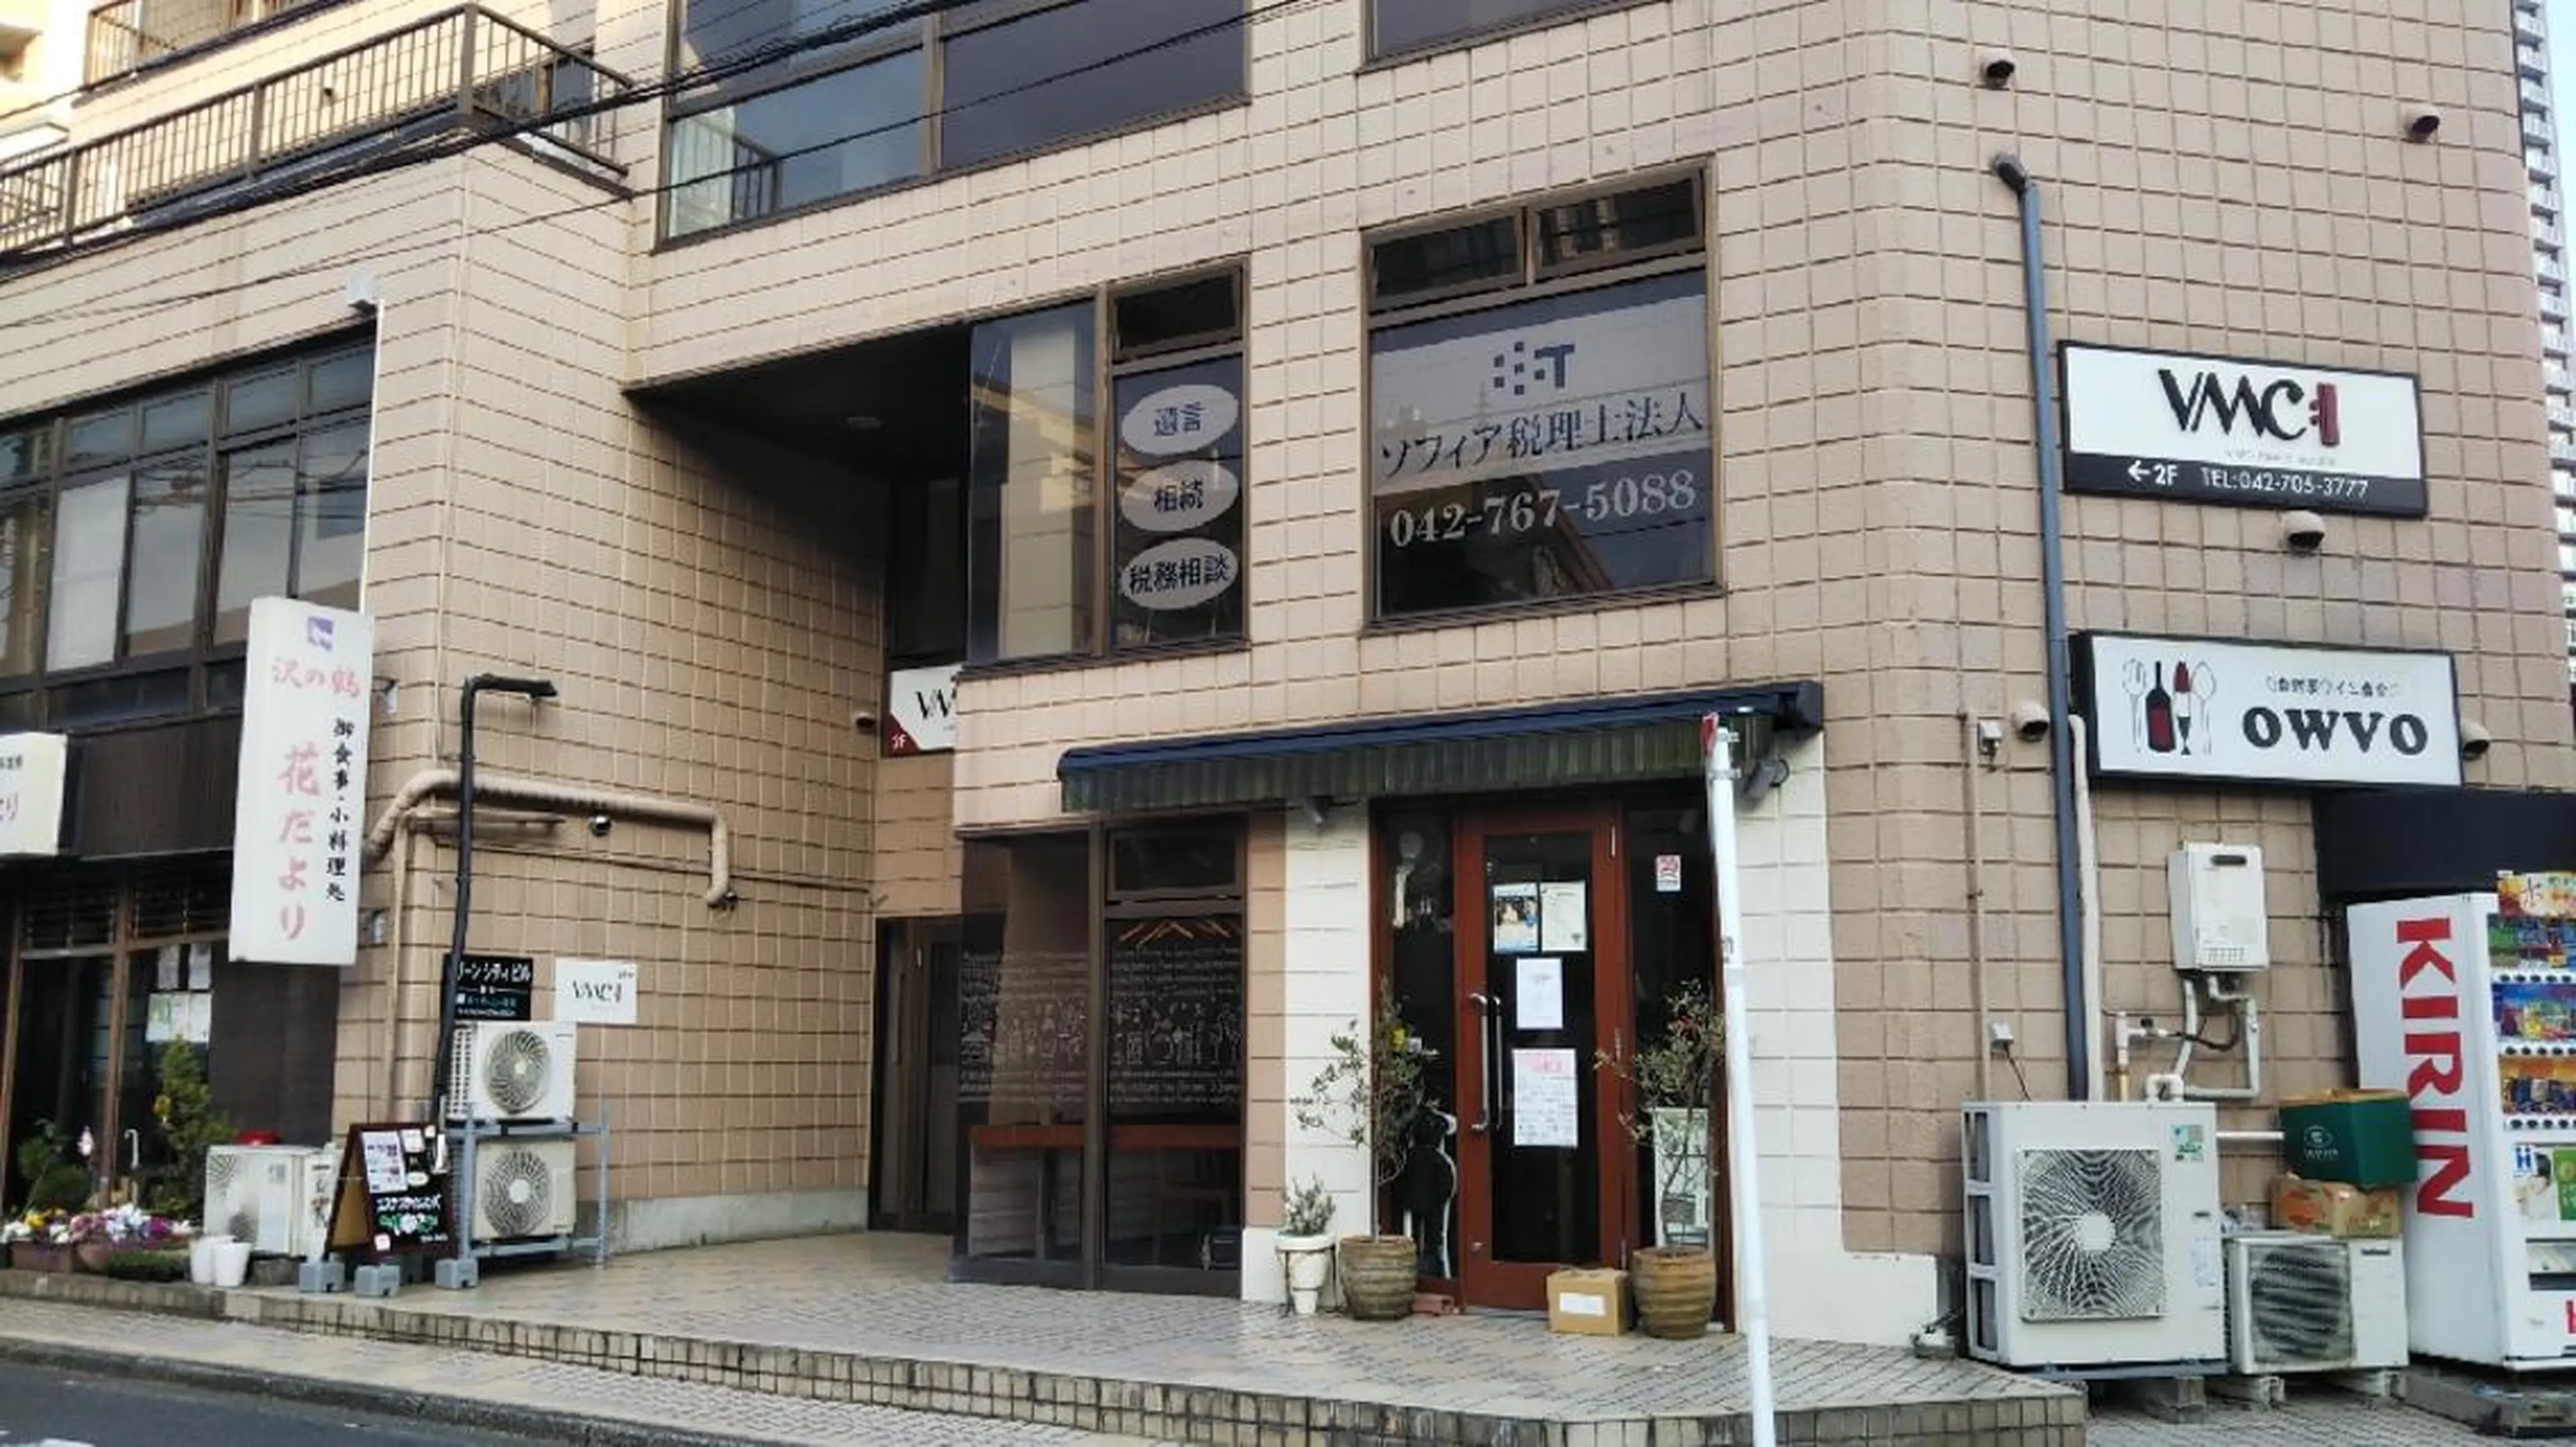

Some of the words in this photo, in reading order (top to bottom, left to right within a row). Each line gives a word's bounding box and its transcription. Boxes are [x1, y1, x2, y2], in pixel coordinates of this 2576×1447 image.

[1154, 400, 1206, 436] 遺言
[1382, 391, 1703, 478] ソフィア税理士法人
[1154, 479, 1203, 513] 相続
[2154, 462, 2179, 488] 2F
[1390, 470, 1697, 548] 042-767-5088
[1129, 552, 1231, 594] 税務相談
[271, 655, 361, 699] 沢の鶴
[325, 718, 356, 902] 御食事・小料理処
[276, 743, 323, 942] 花だより
[2395, 915, 2475, 1220] KIRIN
